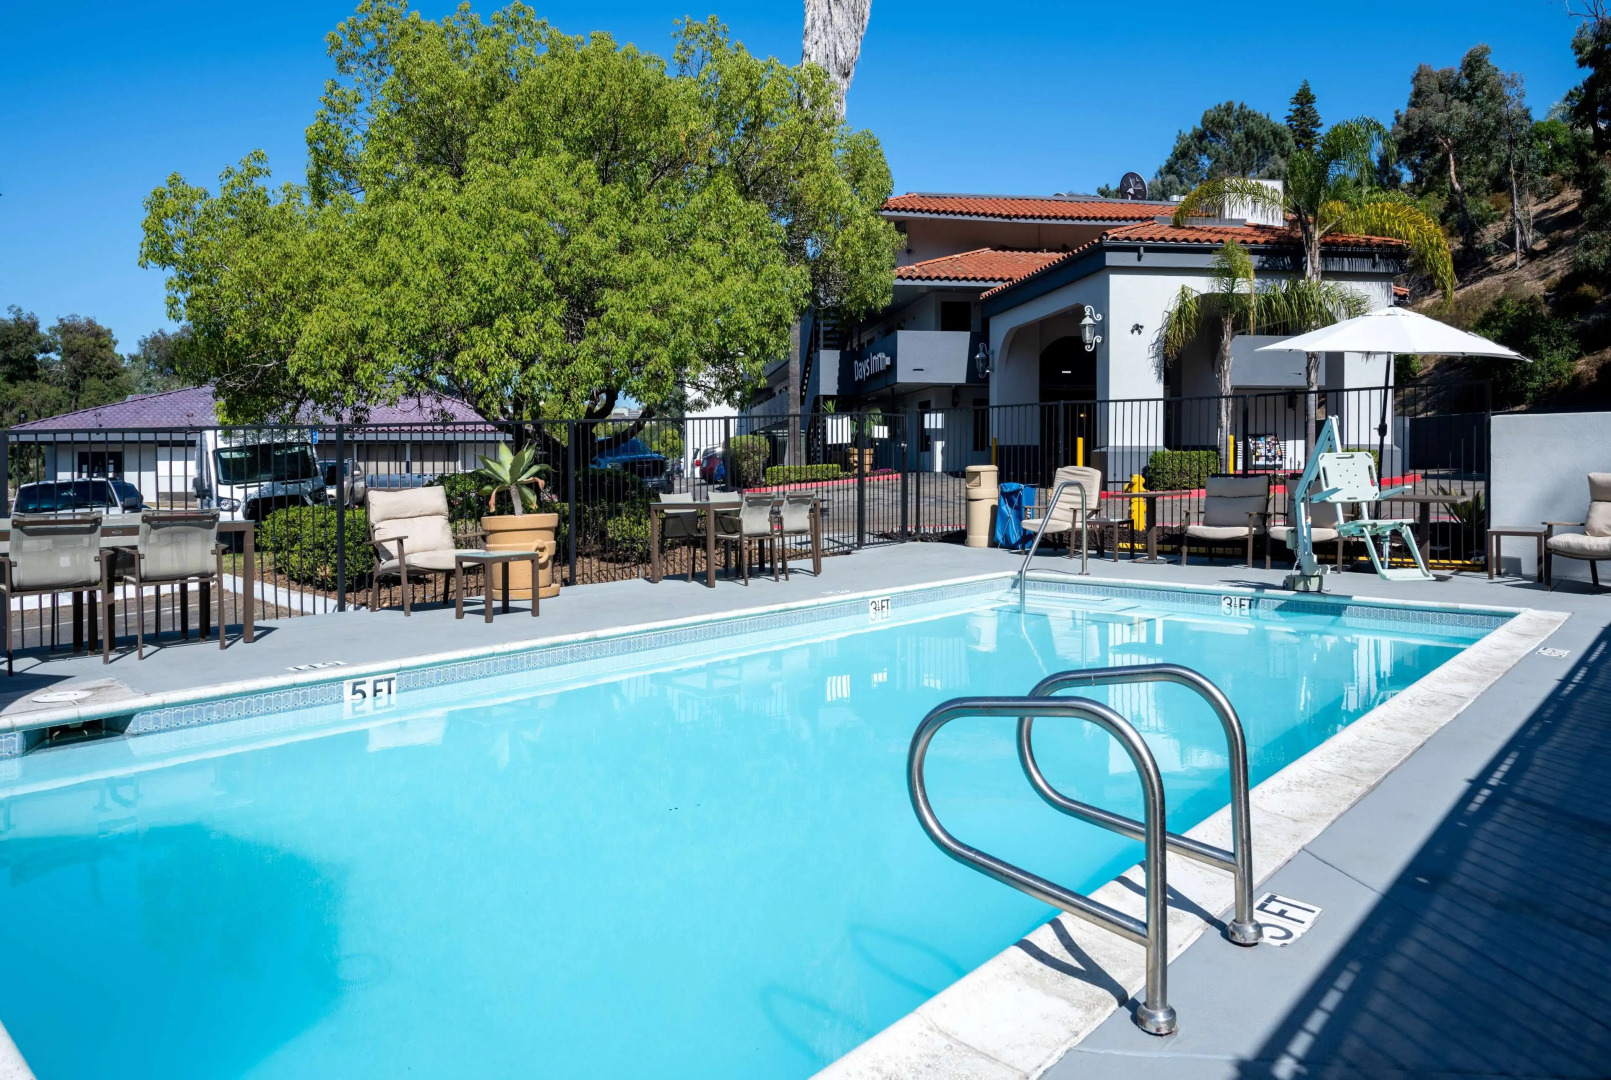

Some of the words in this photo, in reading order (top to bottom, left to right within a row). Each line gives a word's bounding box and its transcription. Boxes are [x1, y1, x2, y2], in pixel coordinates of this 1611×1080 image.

[854, 359, 870, 382] Days
[870, 352, 882, 374] Inn
[880, 599, 890, 610] FT
[1239, 598, 1254, 609] FT
[373, 677, 396, 698] FT
[1256, 894, 1316, 924] FT
